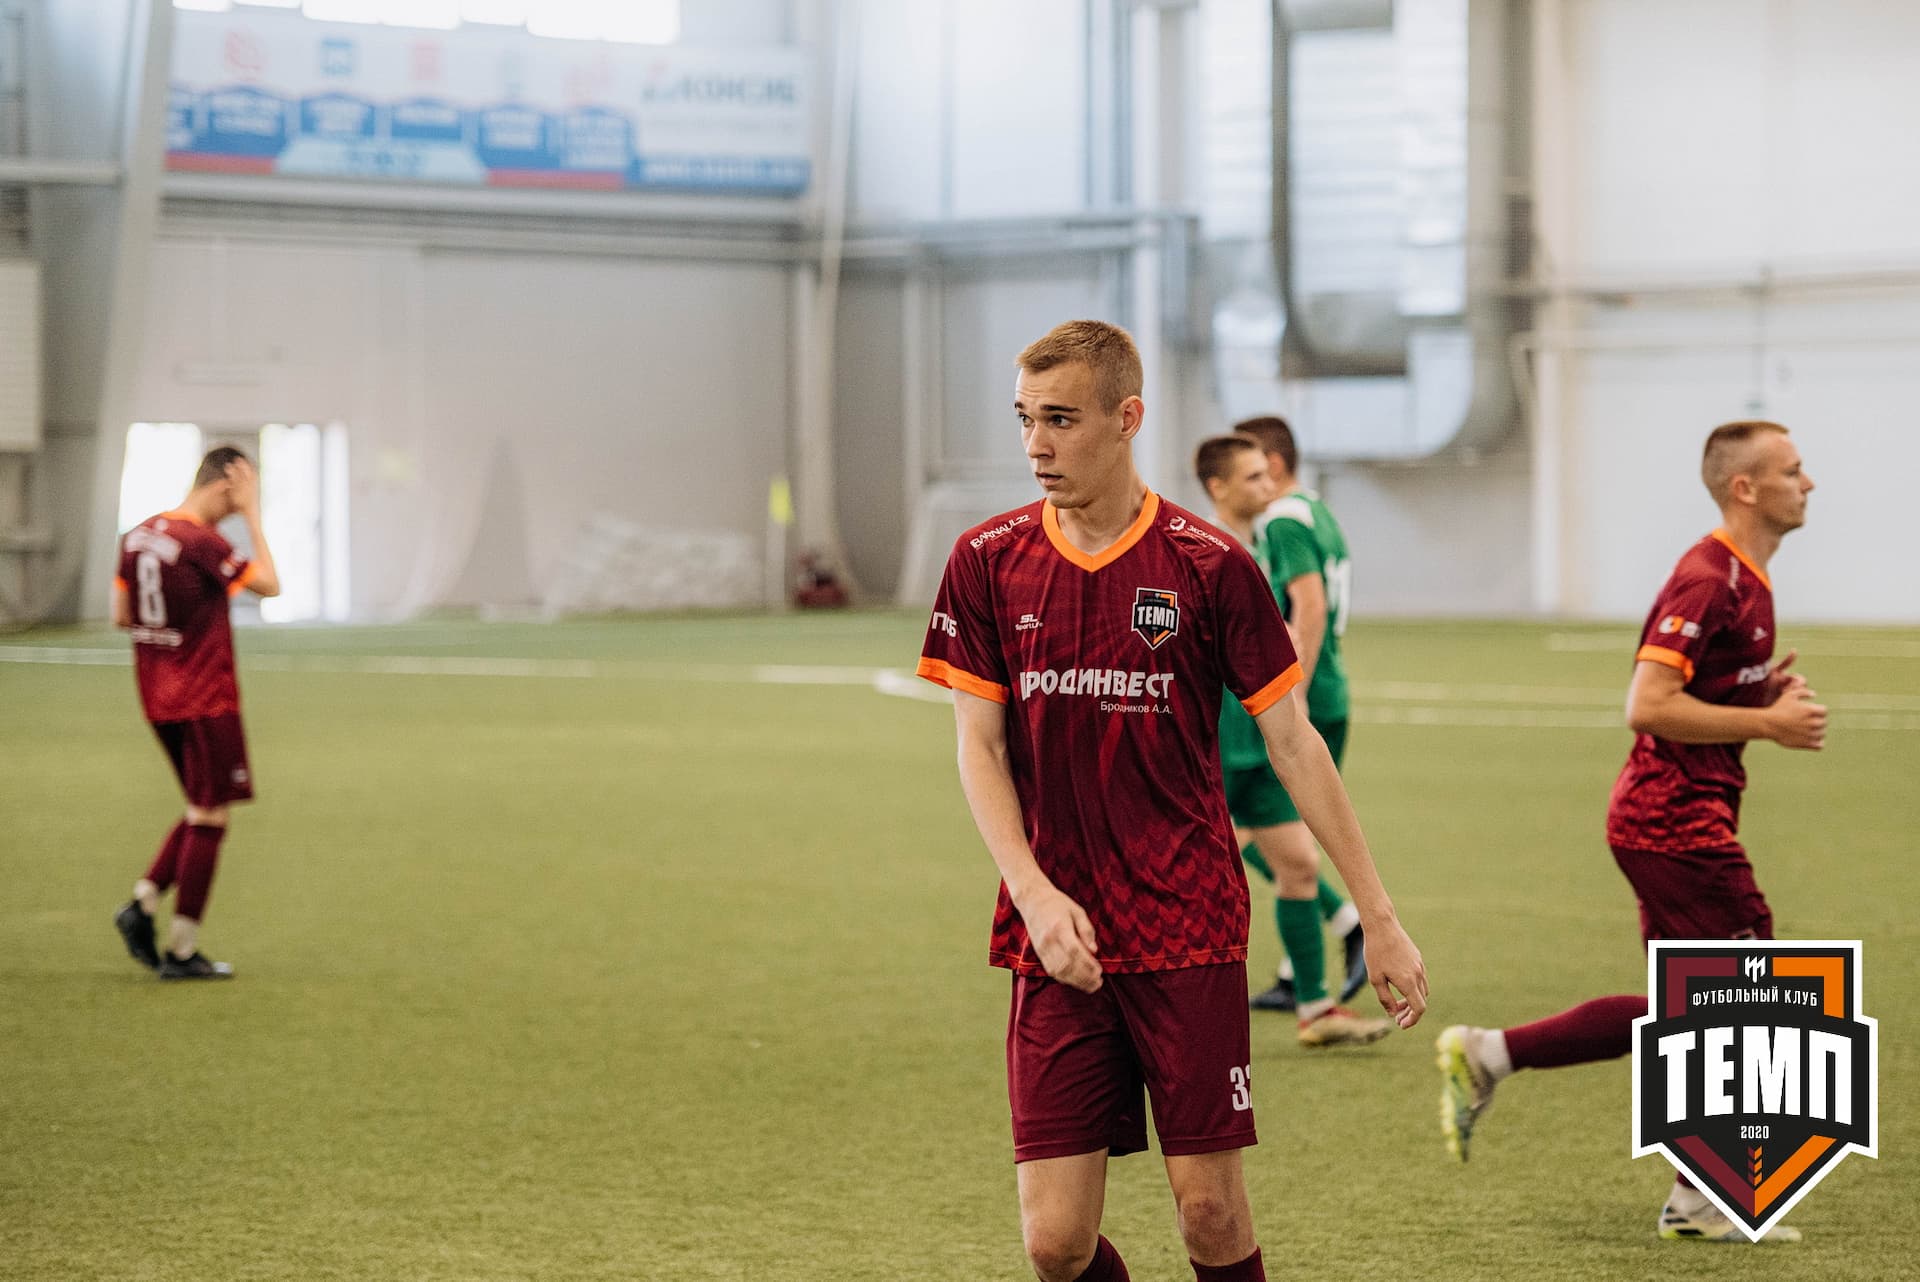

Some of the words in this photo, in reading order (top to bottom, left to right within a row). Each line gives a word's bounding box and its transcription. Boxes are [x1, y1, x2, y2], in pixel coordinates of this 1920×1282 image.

[136, 551, 168, 630] 8
[1137, 605, 1176, 630] ТЕМП
[1230, 1064, 1253, 1111] 3
